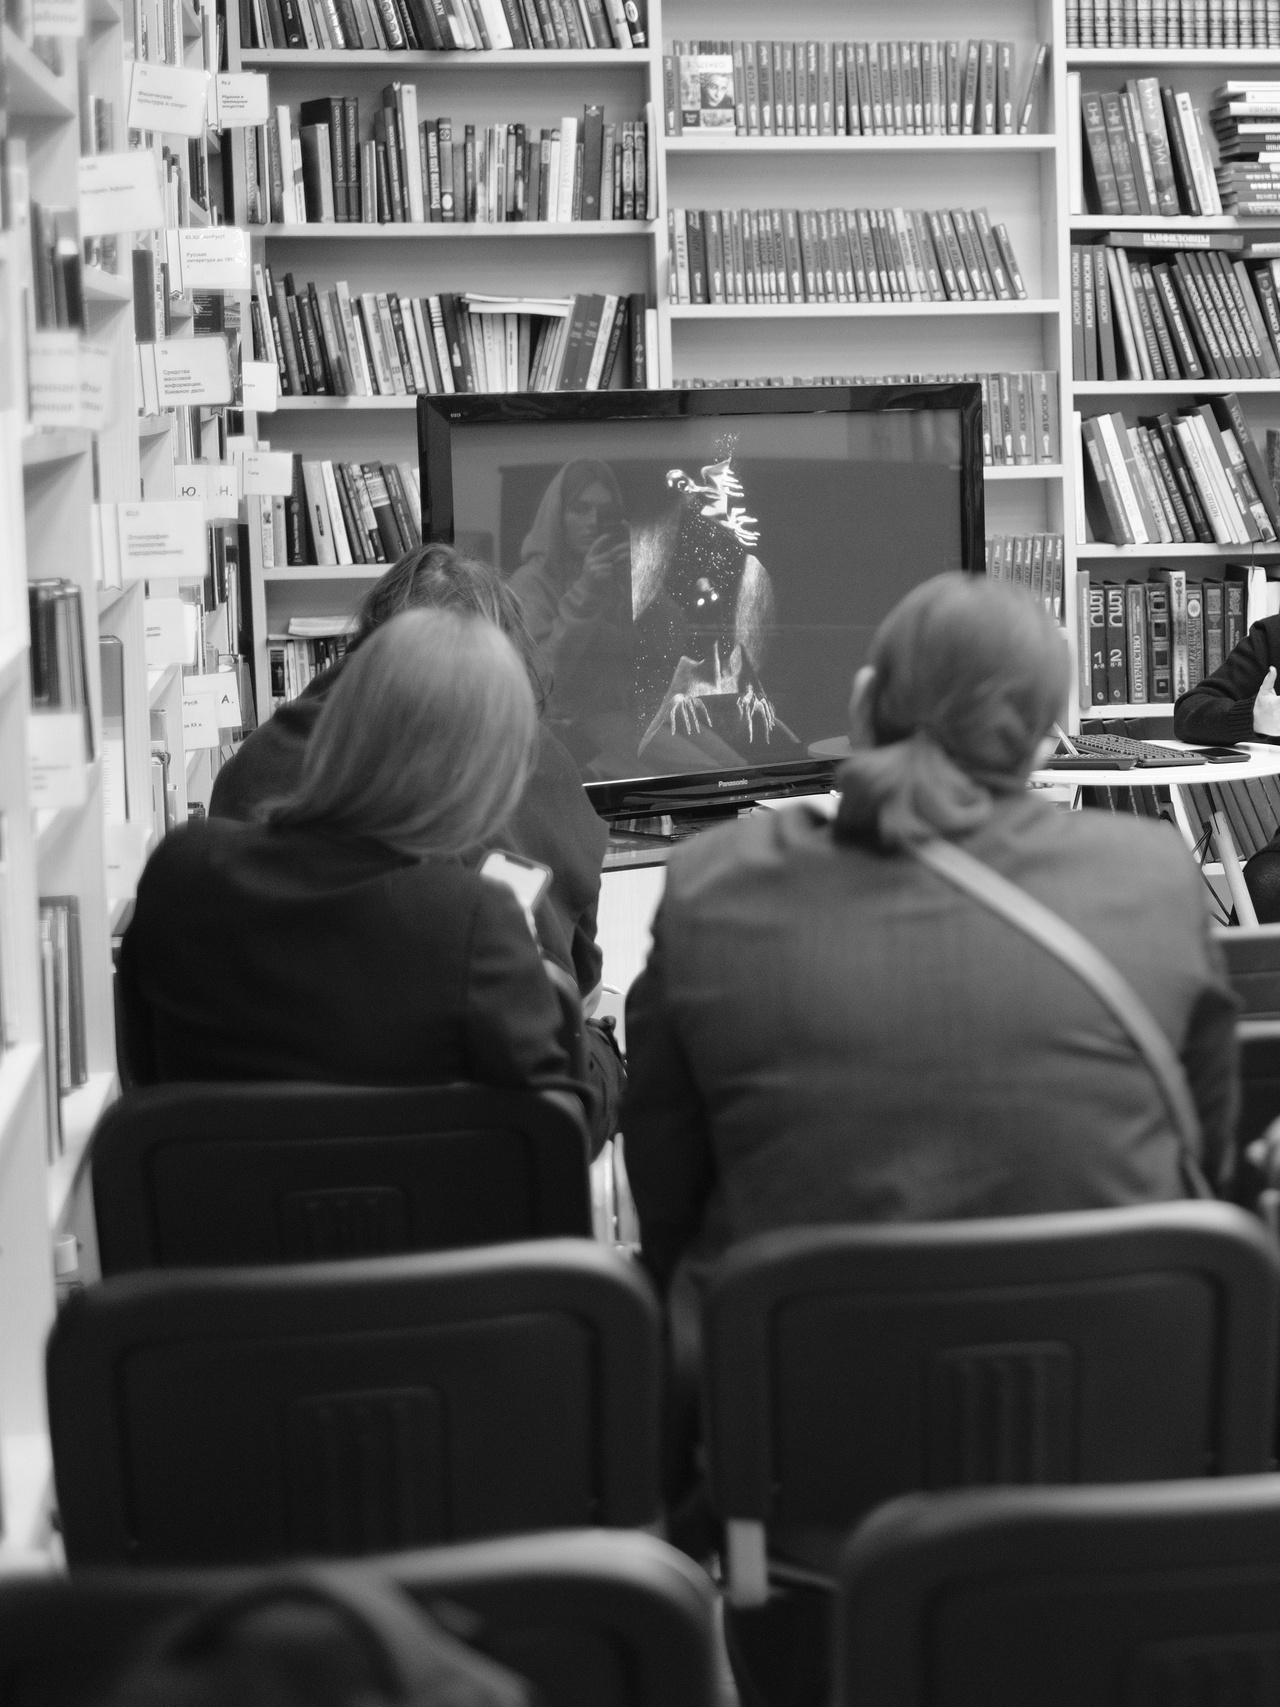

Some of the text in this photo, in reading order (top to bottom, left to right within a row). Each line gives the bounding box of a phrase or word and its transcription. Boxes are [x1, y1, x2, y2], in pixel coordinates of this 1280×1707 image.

[1072, 252, 1081, 325] ИСТОРИЯ МОСКВЫ
[1084, 253, 1094, 328] ИСТОРИЯ МОСКВЫ
[1097, 250, 1109, 323] ИСТОРИЯ МОСКВЫ
[1197, 309, 1221, 358] СИМВОЛИКА
[1208, 309, 1232, 358] СИМВОЛИКА
[1219, 309, 1242, 358] СИМВОЛИКА
[1230, 309, 1253, 358] СИМВОЛИКА
[1240, 308, 1262, 357] СИМВОЛИКА
[1230, 404, 1251, 444] МОСКВА
[1093, 651, 1103, 664] 1
[1109, 649, 1123, 662] 2
[1133, 635, 1143, 691] ОТЕЧЕСТВО
[718, 778, 749, 788] Panasonic
